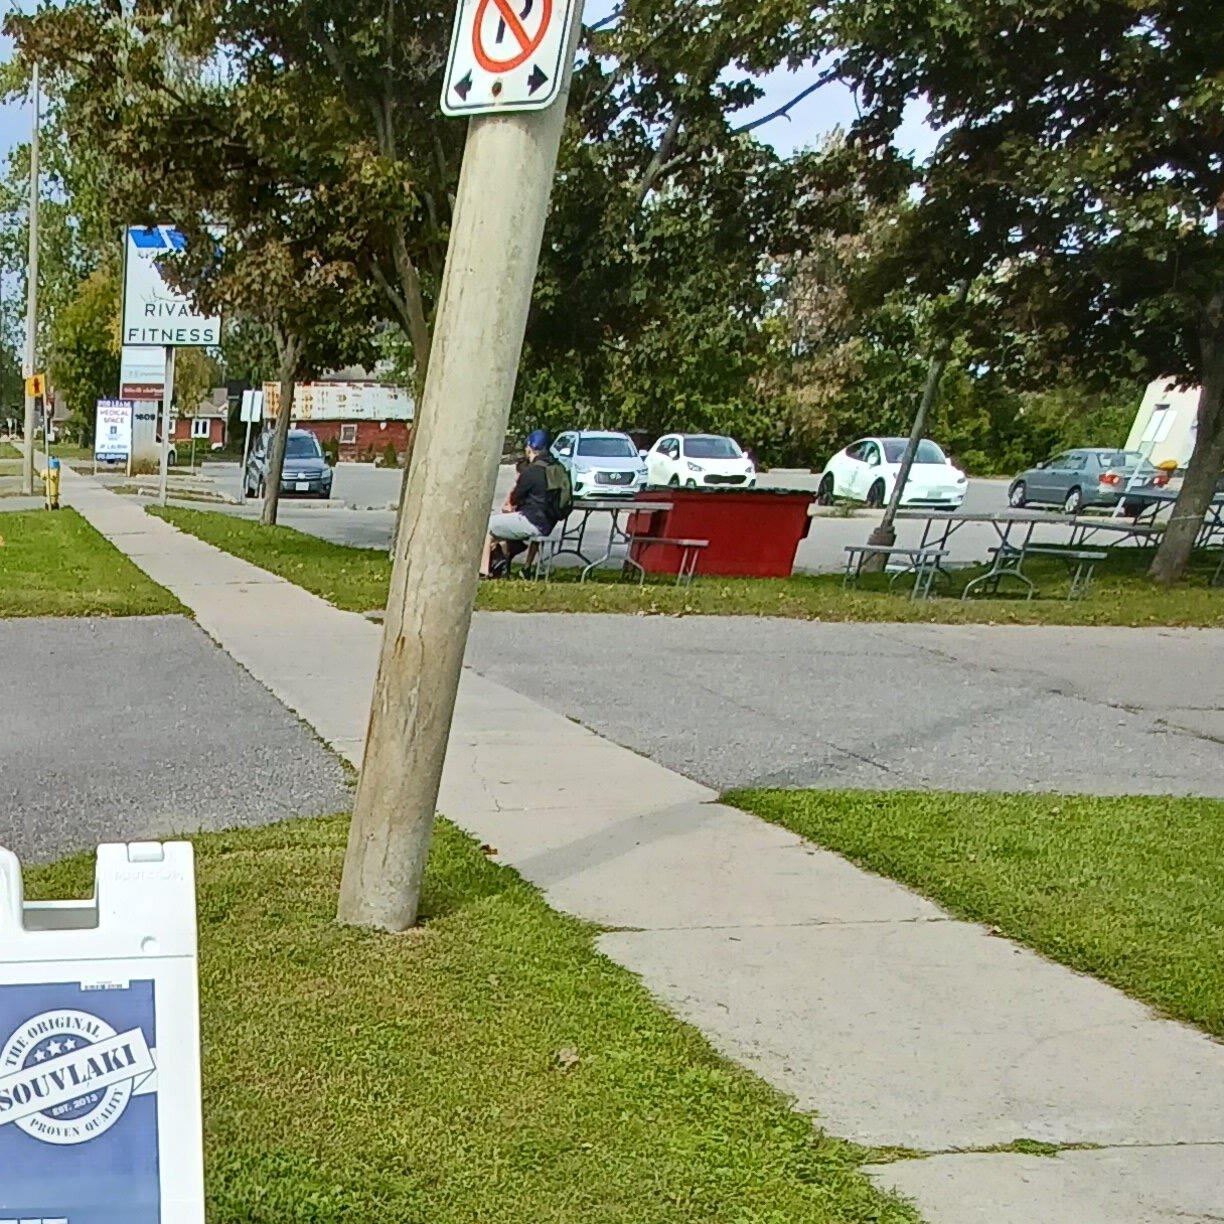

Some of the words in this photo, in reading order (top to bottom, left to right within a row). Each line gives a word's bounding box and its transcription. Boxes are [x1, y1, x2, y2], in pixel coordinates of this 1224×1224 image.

[128, 328, 215, 342] FITNESS
[5, 1036, 28, 1067] THE
[27, 1016, 100, 1039] ORIGINAL
[30, 1118, 80, 1137] PROVEN
[85, 1088, 123, 1132] QUALITY
[52, 1103, 72, 1116] EST.
